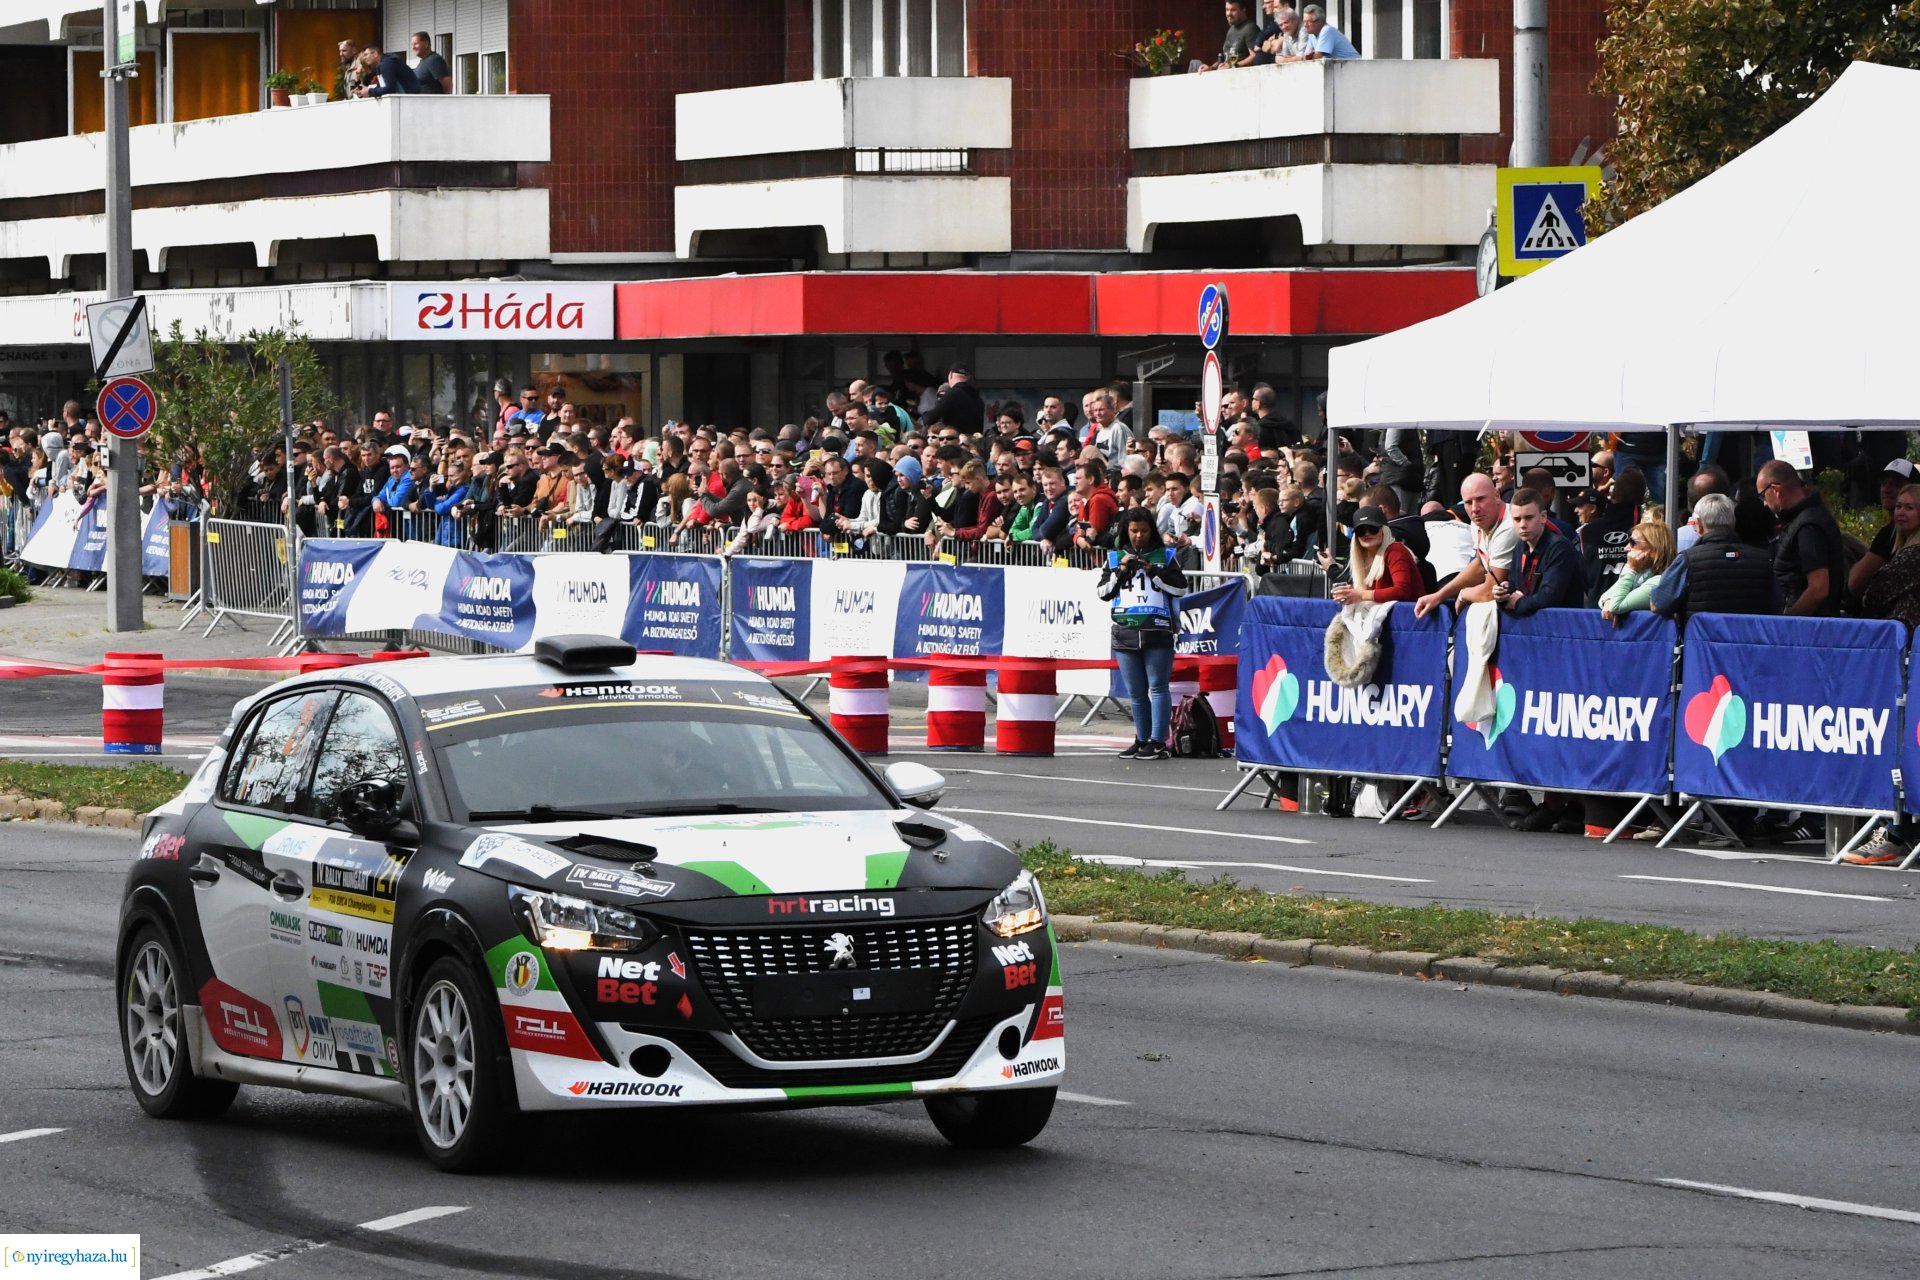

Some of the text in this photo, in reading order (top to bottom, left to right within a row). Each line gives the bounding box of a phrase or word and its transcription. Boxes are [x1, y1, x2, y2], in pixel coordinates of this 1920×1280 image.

[458, 293, 585, 329] Háda
[311, 562, 354, 585] HUMDA
[470, 576, 511, 601] HUMDA
[568, 580, 607, 603] HUMDA
[661, 580, 700, 606] HUMDA
[757, 586, 795, 611] HUMDA
[1136, 595, 1148, 603] TV
[475, 604, 491, 616] ROAD
[492, 605, 513, 617] SAFETY
[834, 589, 875, 613] HUMDA
[933, 592, 983, 621] HUMDA
[1040, 600, 1084, 624] HUMDA
[644, 610, 667, 622] HUMDA
[748, 616, 765, 627] HUMDA
[766, 617, 779, 628] ROAD
[1180, 607, 1215, 634] MDA
[643, 626, 649, 637] A
[918, 623, 982, 639] HUMDA ROAD SAFETY
[915, 643, 922, 653] A
[952, 644, 963, 654] AZ
[1306, 679, 1433, 728] HUNGARY
[1520, 690, 1658, 742] HUNGARY
[1752, 702, 1890, 756] HUNGARY
[342, 869, 372, 891] HUNGARY
[573, 868, 587, 878] IV.
[588, 870, 618, 882] RALLY
[619, 877, 668, 892] HUNGARY
[328, 894, 336, 905] FIA
[348, 898, 376, 914] Championship
[356, 932, 388, 956] HUMDA
[991, 940, 1035, 967] Net
[598, 956, 661, 980] Net
[1003, 961, 1037, 990] Bet
[596, 979, 657, 1005] Bet
[312, 1041, 334, 1061] OMV
